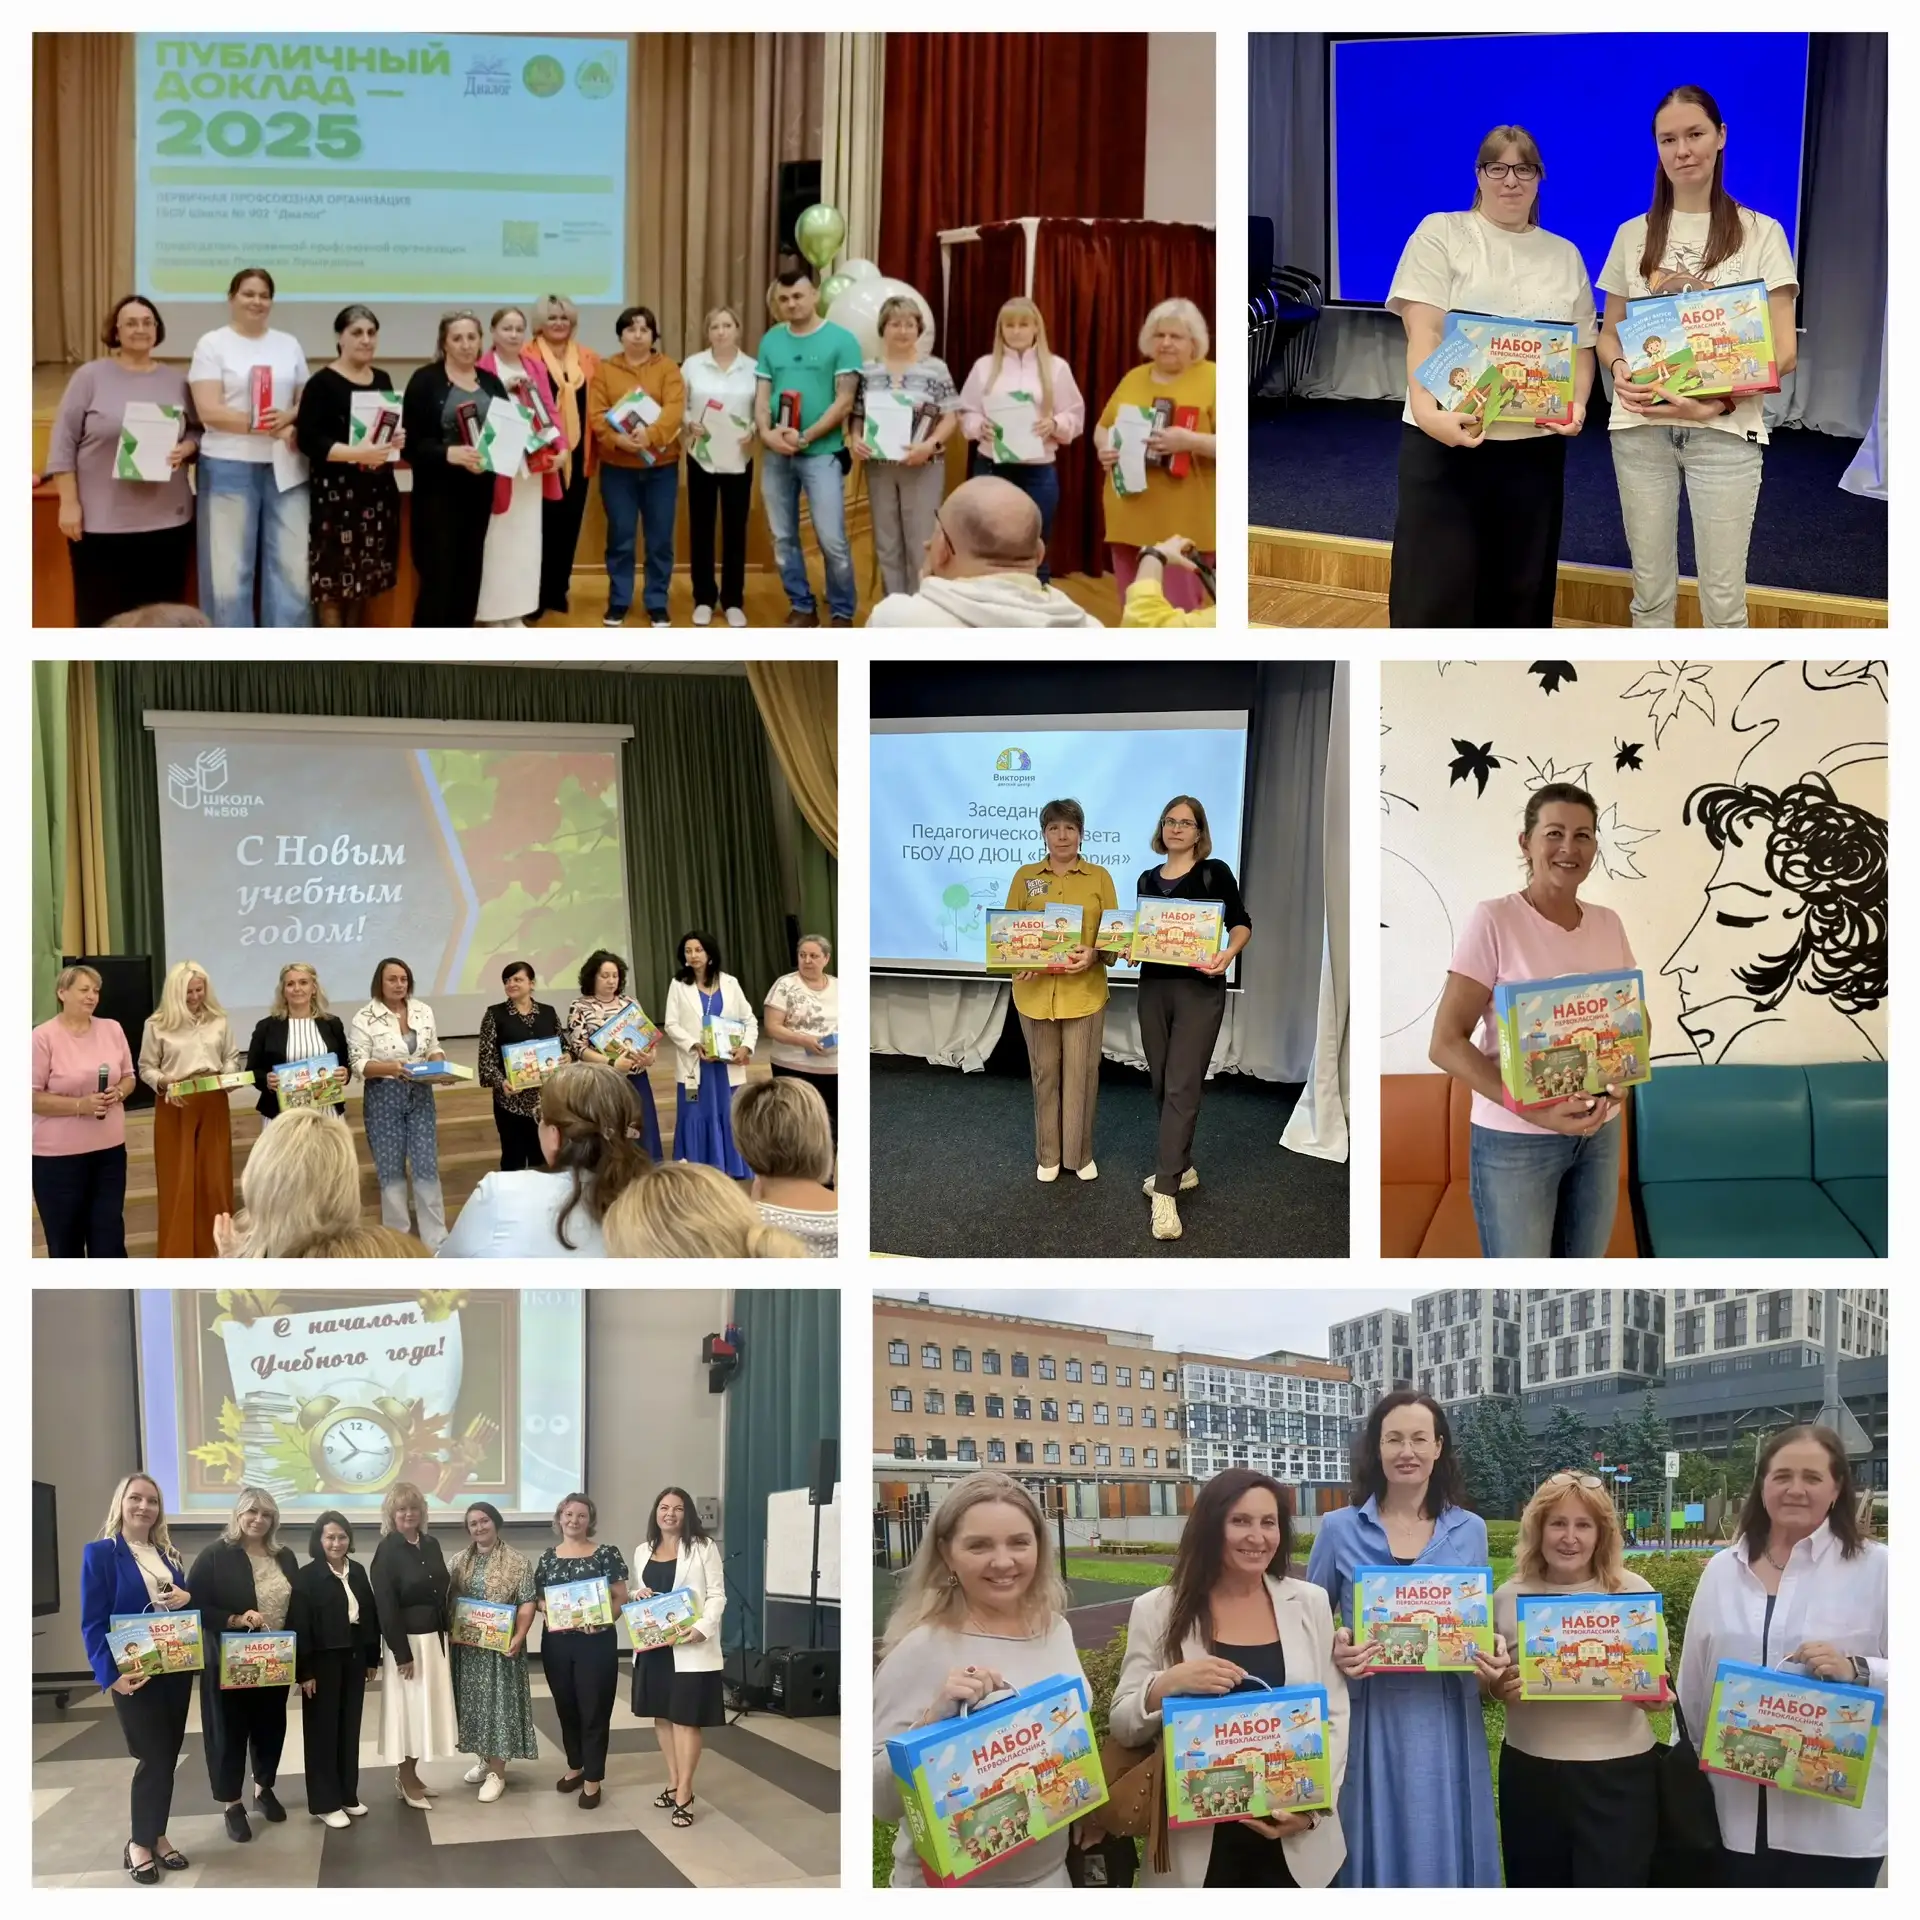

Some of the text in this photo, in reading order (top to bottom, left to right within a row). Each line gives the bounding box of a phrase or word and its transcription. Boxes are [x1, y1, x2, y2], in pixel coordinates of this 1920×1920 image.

[155, 41, 451, 76] ПУБЛИЧНЫЙ
[155, 71, 356, 107] ДОКЛАД
[156, 109, 363, 159] 2025
[1681, 308, 1726, 325] АБОР
[1685, 321, 1727, 330] ОКЛАССНИКА
[1491, 337, 1542, 353] НАБОР
[1490, 351, 1541, 360] ПЕРВОКЛАССНИКА
[993, 773, 1036, 783] Виктория
[203, 794, 265, 806] ШКОЛА
[968, 802, 1041, 820] Заседан
[912, 824, 1121, 843] Педагогическо вета
[237, 834, 407, 866] С Новым
[903, 845, 944, 861] ГБОУ
[948, 848, 974, 864] ДО
[979, 848, 1023, 866] ДЮЦ
[236, 877, 403, 916] учебным
[1161, 911, 1197, 921] НАБОР
[239, 915, 367, 946] годом!
[1553, 998, 1609, 1019] НАБОР
[1554, 1013, 1610, 1027] ПЕРВОКЛАССНИКА
[273, 1312, 418, 1338] С началом
[251, 1336, 446, 1380] Учебного года!
[350, 1422, 363, 1431] 12
[327, 1446, 334, 1455] 9
[383, 1446, 390, 1455] 3
[356, 1471, 363, 1480] 6
[1396, 1586, 1452, 1599] НАБОР
[472, 1610, 495, 1619] НАБОР
[1562, 1615, 1620, 1628] НАБОР
[244, 1643, 275, 1651] НАБОР
[1759, 1694, 1828, 1719] НАБОР
[1758, 1708, 1824, 1727] ПЕРВОКЛАССНИКА
[1214, 1717, 1281, 1739] НАБОР
[972, 1722, 1043, 1767] НАБОР
[1215, 1733, 1281, 1746] ПЕРВОКЛАССНИКА
[977, 1740, 1047, 1775] ПЕРВОКЛАССНИКА
